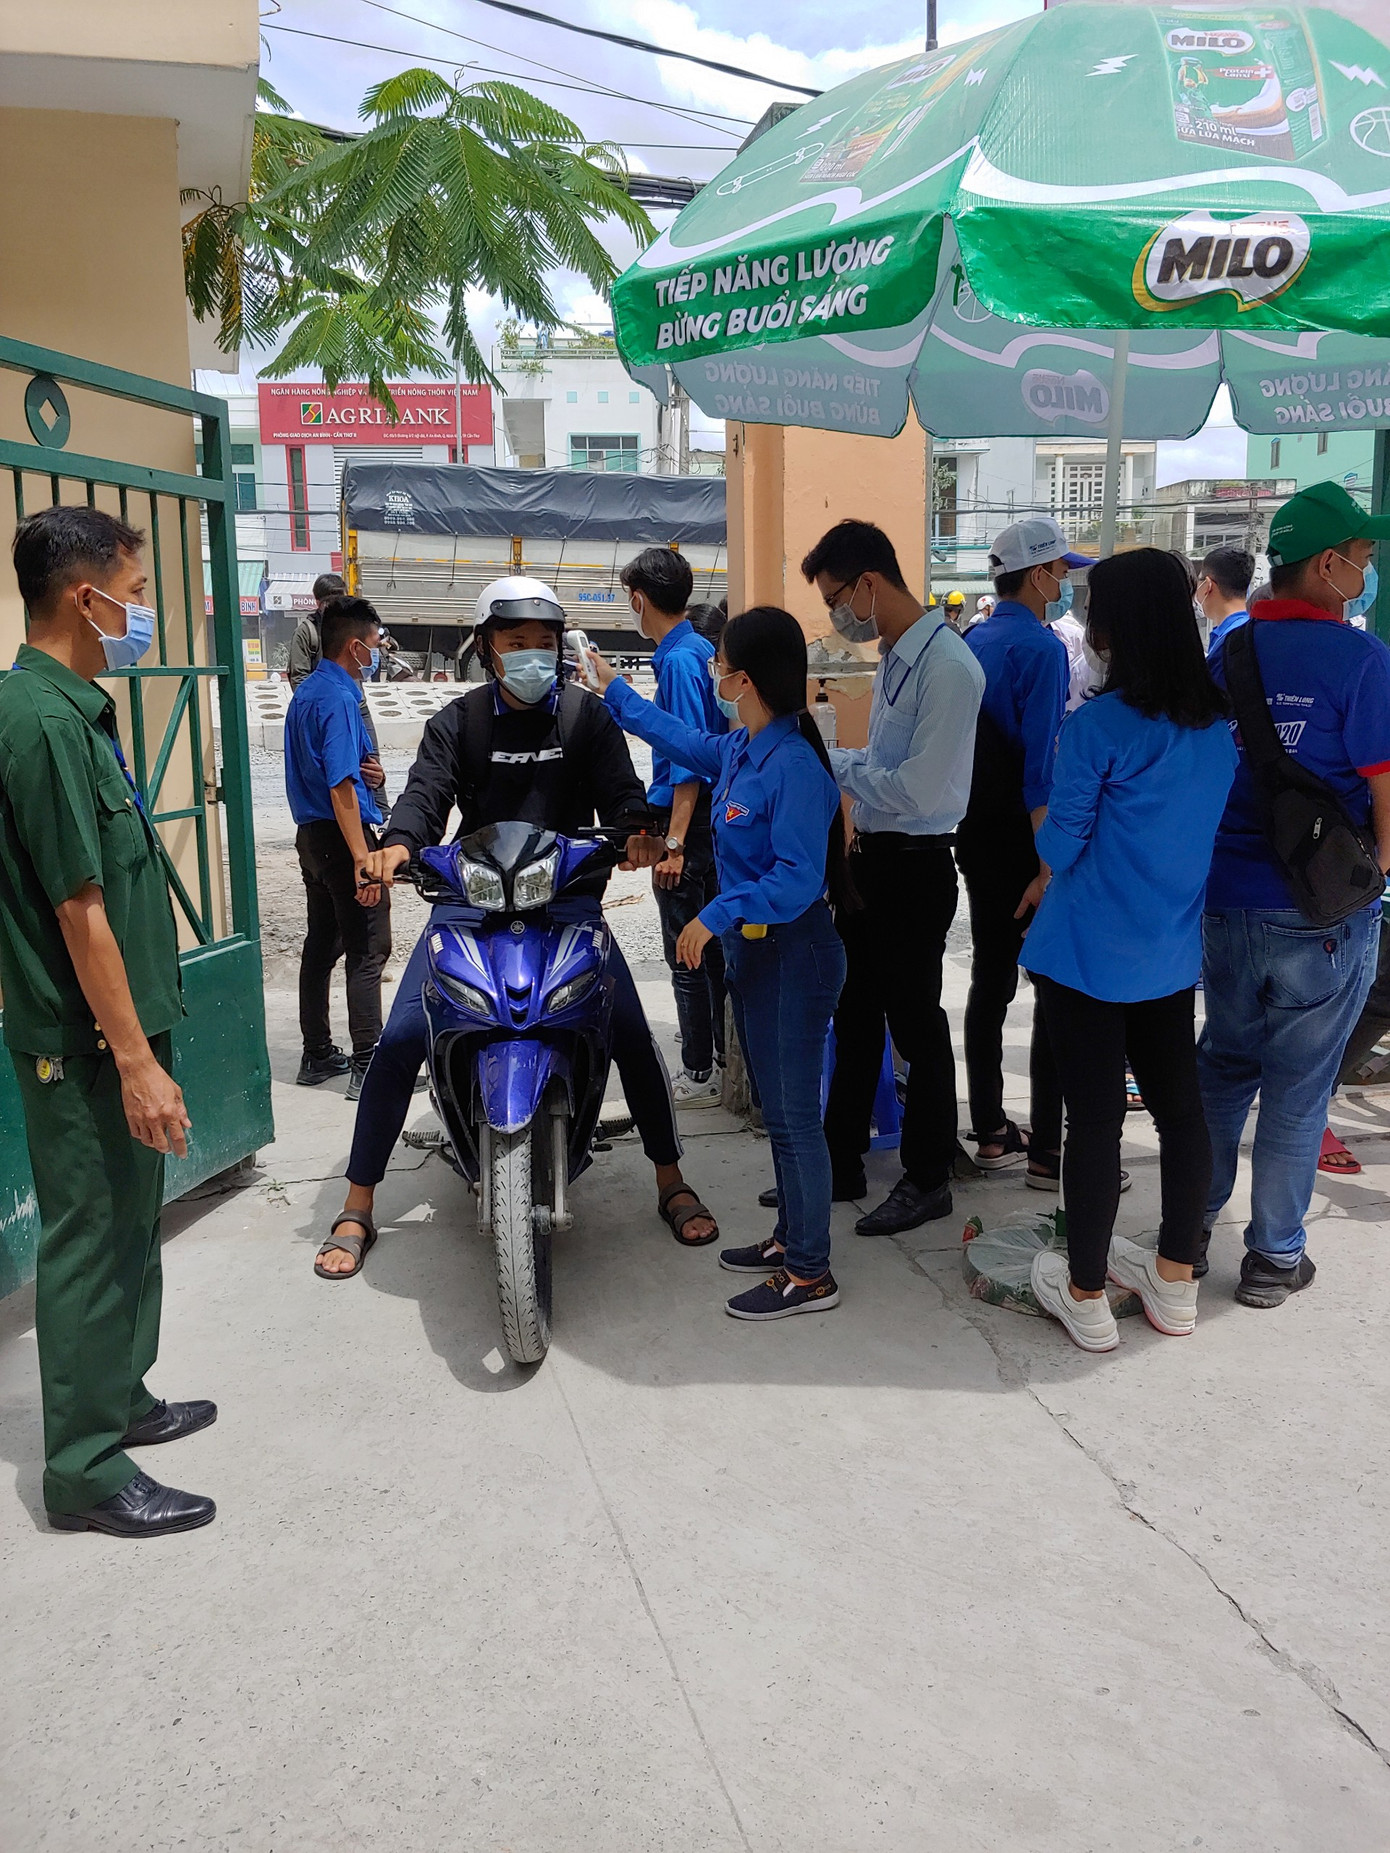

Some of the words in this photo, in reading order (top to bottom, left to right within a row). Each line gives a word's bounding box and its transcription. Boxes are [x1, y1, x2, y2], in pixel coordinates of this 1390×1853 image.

[1171, 34, 1245, 49] MILO
[1195, 120, 1217, 132] 210
[1220, 125, 1237, 136] ml
[1223, 134, 1255, 147] MẠCH
[1156, 235, 1294, 284] MILO
[655, 264, 708, 307] TIẾP
[713, 254, 789, 296] NĂNG
[797, 235, 895, 284] LƯỢNG
[656, 311, 722, 350] BỪNG
[726, 290, 797, 337] BUỔI
[798, 282, 869, 324] SÁNG
[271, 387, 290, 396] NGÂN
[291, 387, 311, 396] HÀNG
[407, 387, 427, 396] NÔNG
[428, 387, 446, 396] THÔN
[447, 387, 460, 397] VIỆ
[463, 388, 478, 396] NAM
